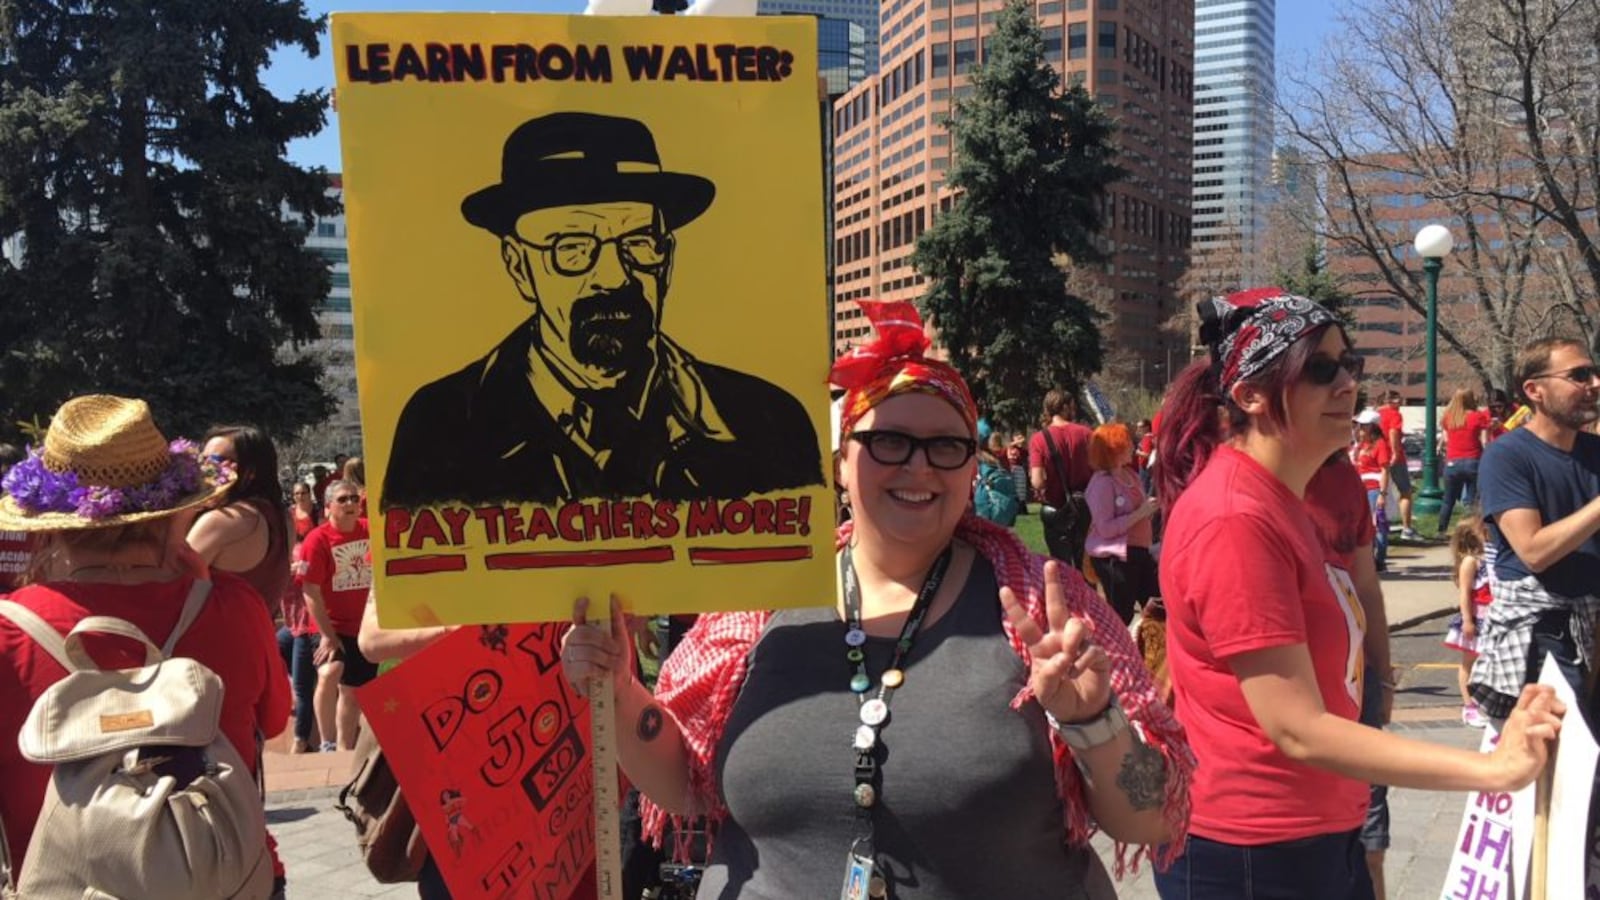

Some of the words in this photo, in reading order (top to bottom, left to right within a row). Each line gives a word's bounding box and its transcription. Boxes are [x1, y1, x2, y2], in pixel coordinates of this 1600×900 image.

[346, 43, 486, 84] LEARN
[491, 42, 612, 83] FROM
[623, 43, 794, 82] WALTER:
[385, 505, 470, 550] PAY
[474, 500, 680, 545] TEACHERS
[686, 495, 811, 538] MORE!
[421, 668, 503, 753] DO
[542, 745, 576, 790] SO
